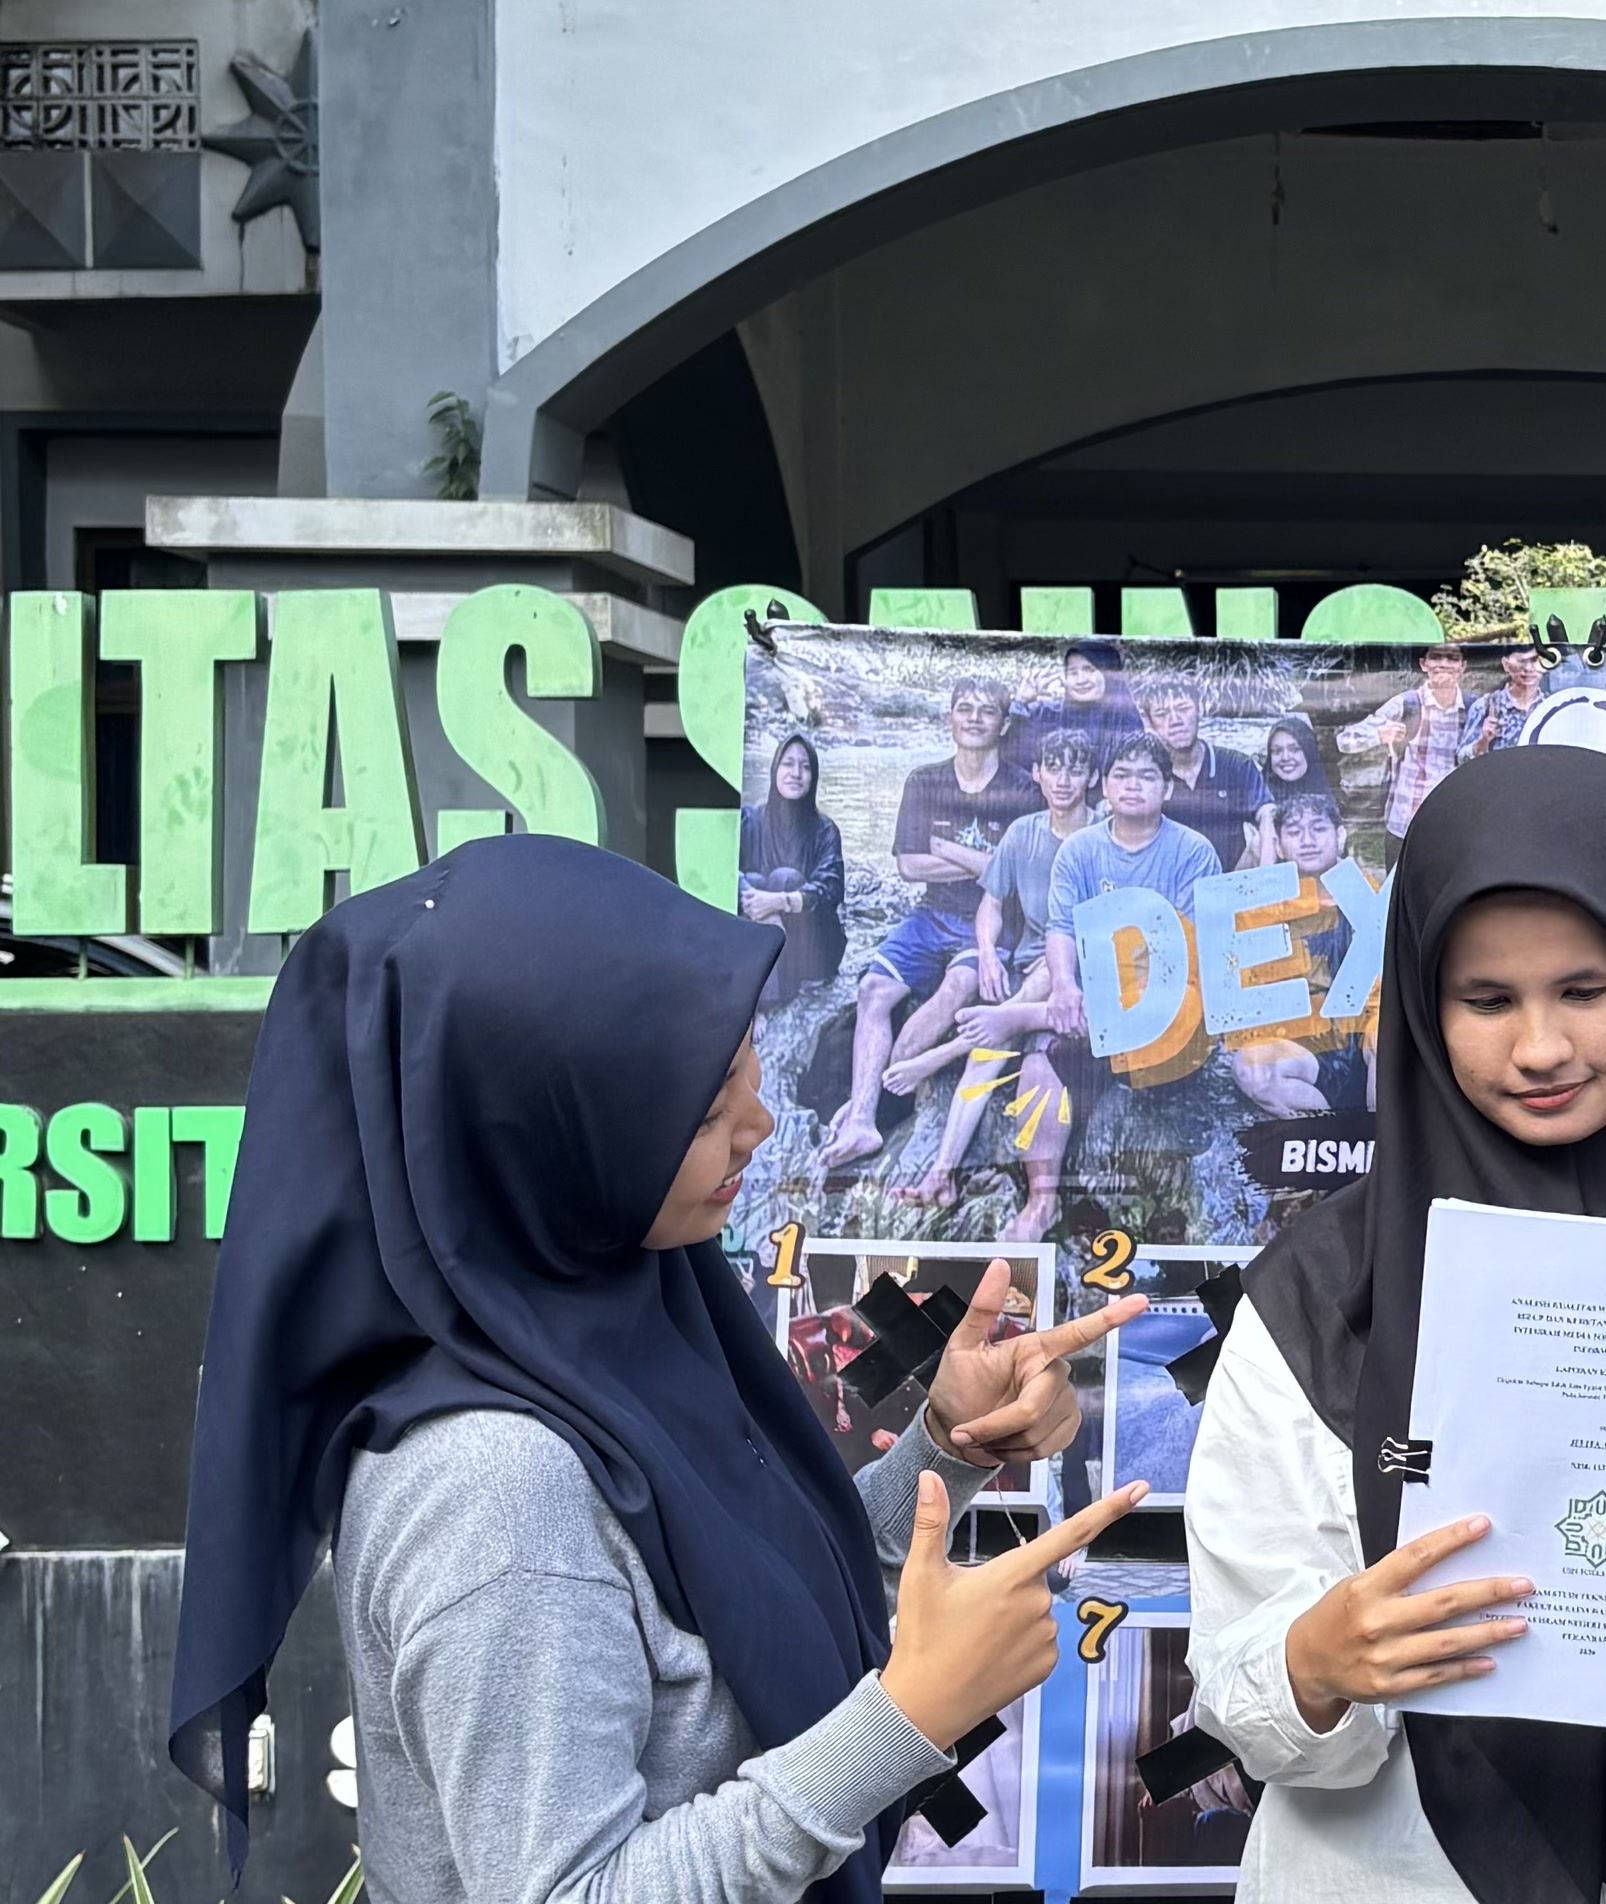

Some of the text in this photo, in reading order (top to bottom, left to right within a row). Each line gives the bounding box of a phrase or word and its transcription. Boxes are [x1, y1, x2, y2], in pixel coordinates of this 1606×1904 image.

[768, 1222, 805, 1288] 1
[1081, 1229, 1137, 1293] 2
[1077, 1597, 1129, 1663] 7
